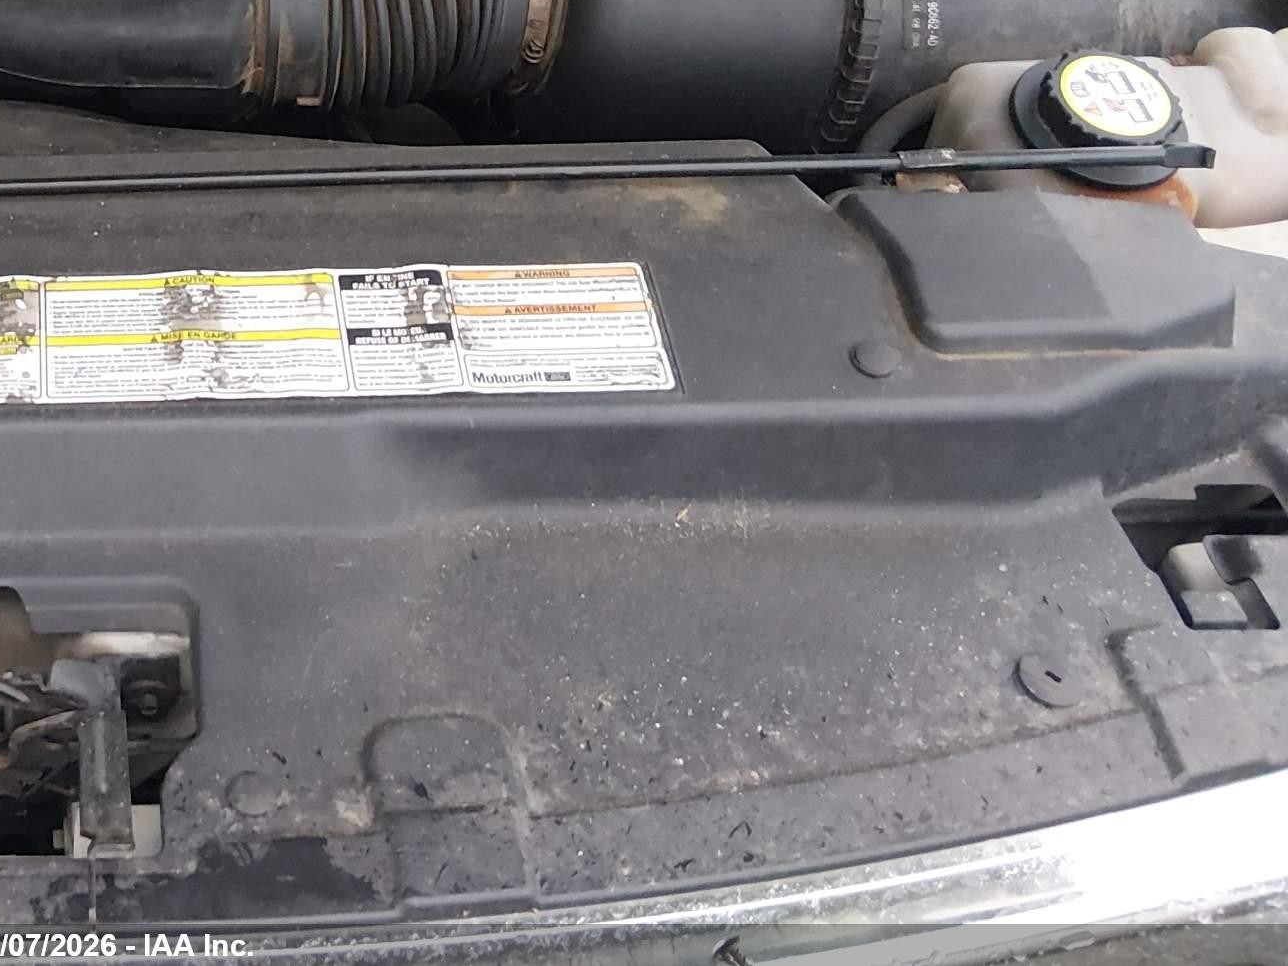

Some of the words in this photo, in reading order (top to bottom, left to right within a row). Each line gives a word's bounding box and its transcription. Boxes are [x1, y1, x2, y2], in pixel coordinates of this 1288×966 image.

[521, 269, 570, 278] WARNING
[172, 275, 215, 285] CAUTION
[513, 304, 597, 314] AVERTISSEMENT
[161, 330, 183, 340] MISE
[187, 330, 200, 339] EN
[203, 331, 237, 340] GARDE
[471, 370, 543, 385] Motorcraft
